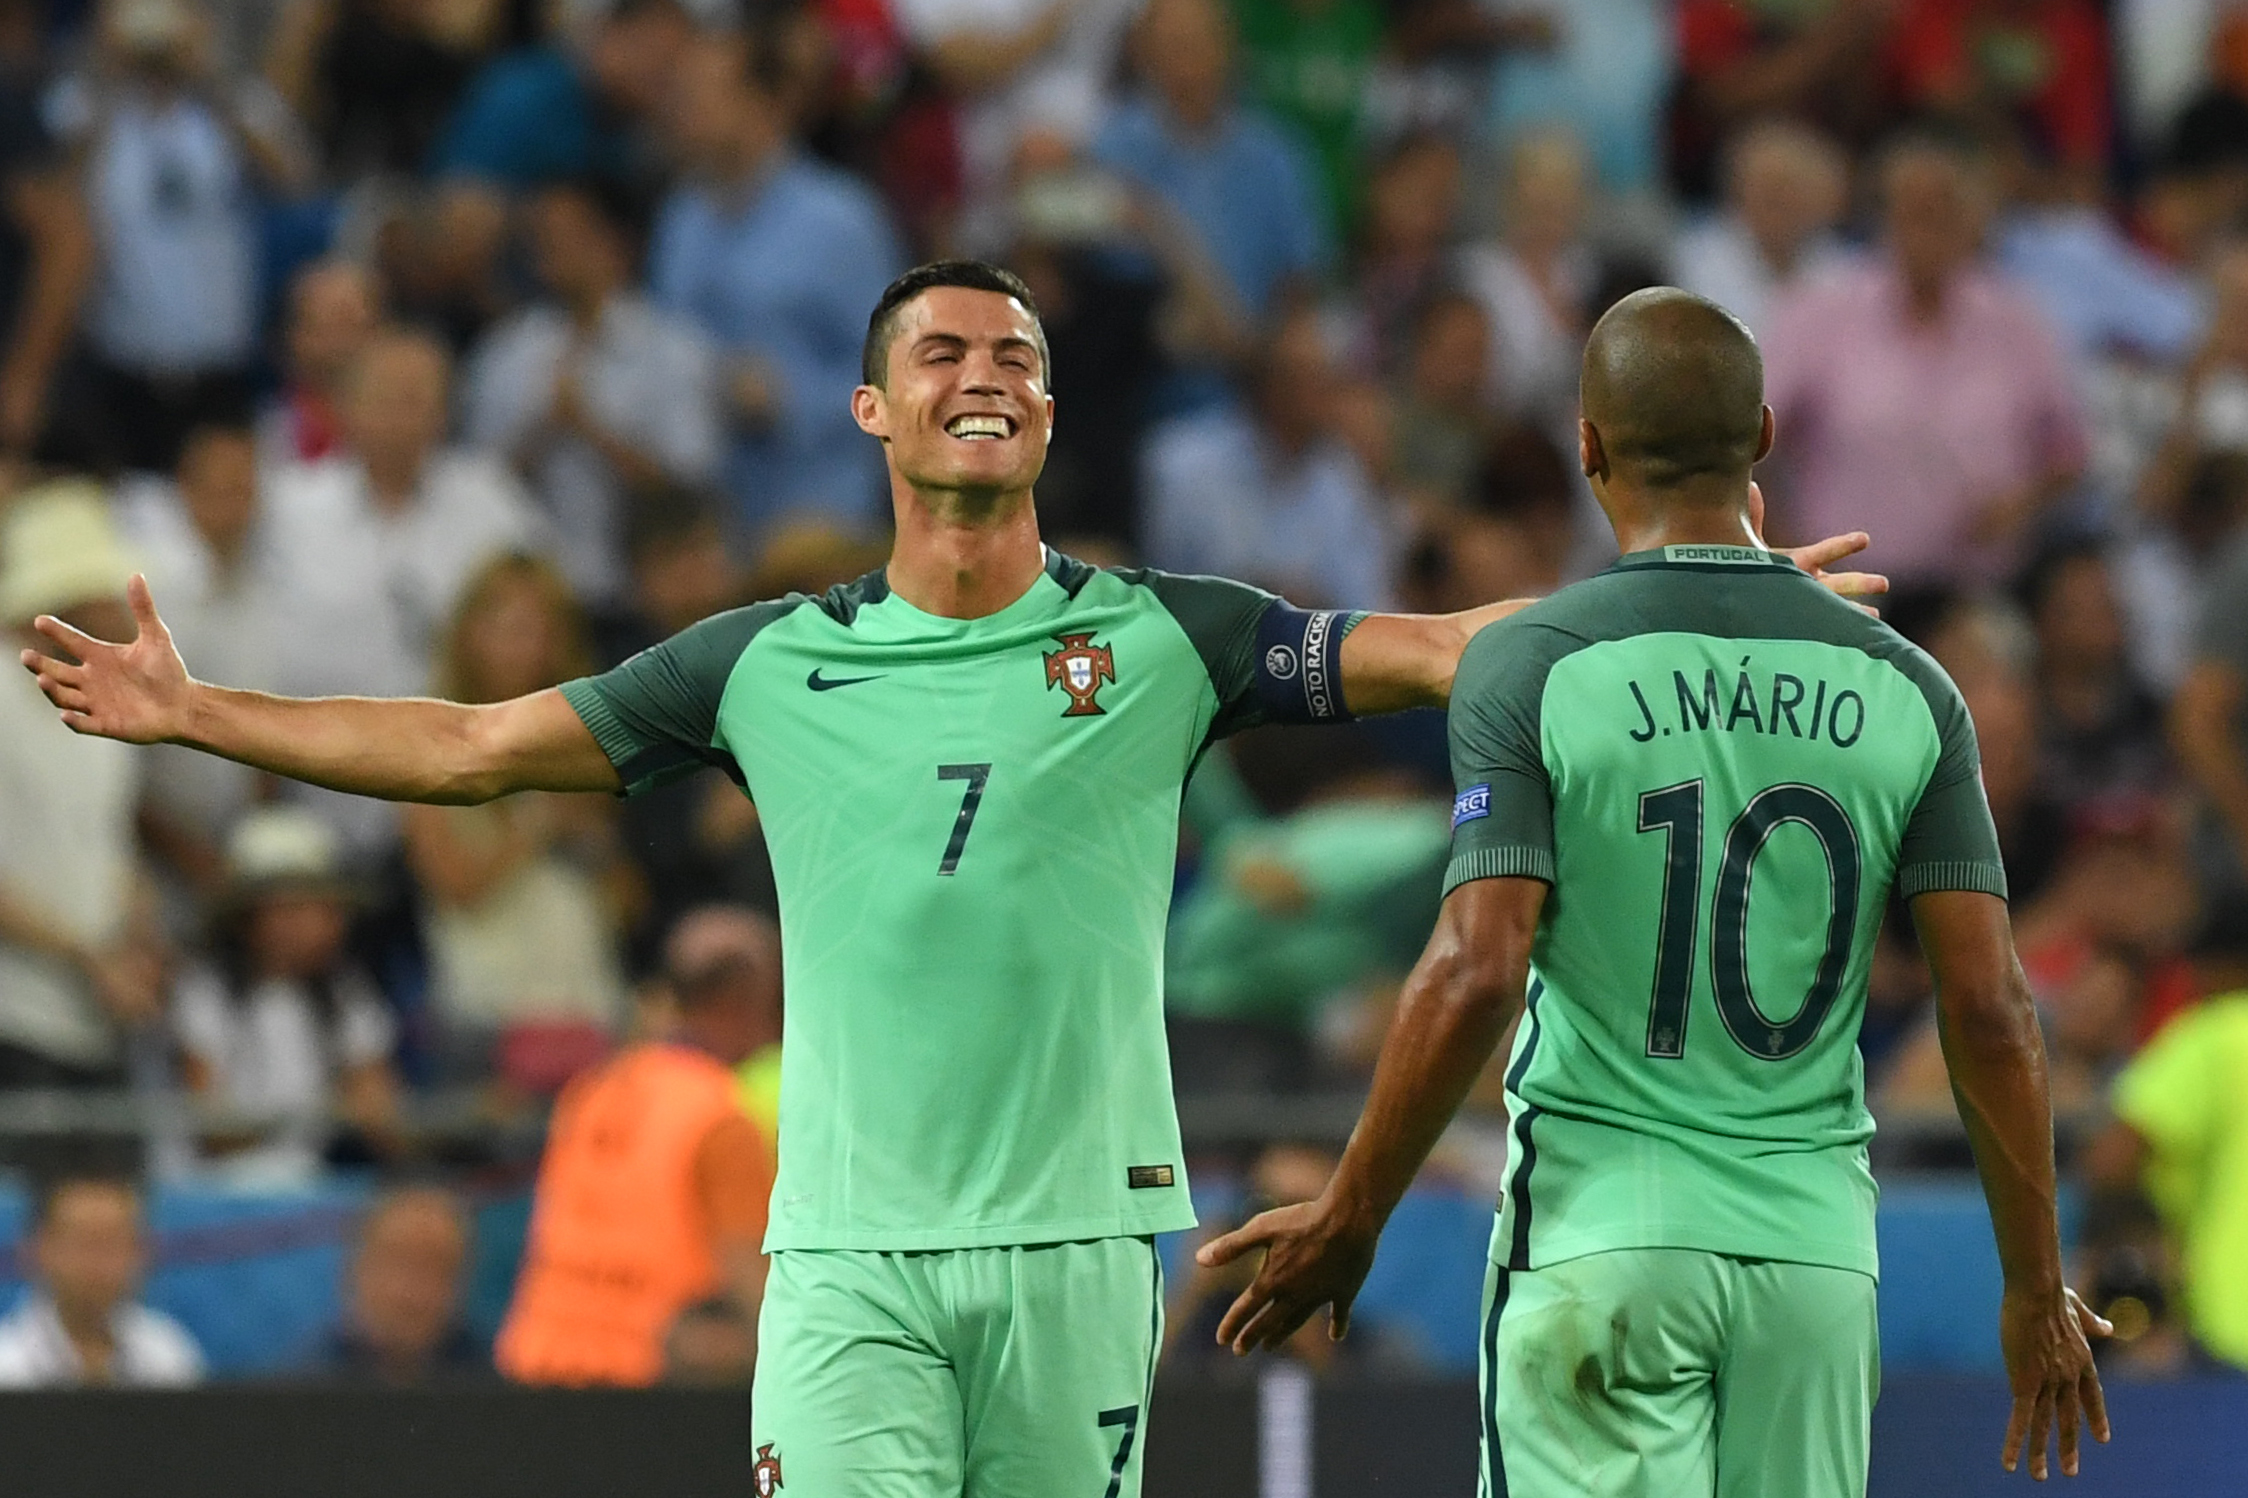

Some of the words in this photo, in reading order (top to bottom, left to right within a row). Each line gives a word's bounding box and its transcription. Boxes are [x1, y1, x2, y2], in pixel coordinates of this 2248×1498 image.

[1674, 548, 1765, 562] PORTUGAL
[1308, 671, 1323, 694] TO
[1312, 695, 1329, 717] NO
[1627, 655, 1865, 748] J.MÁRIO
[936, 763, 993, 876] 7
[1636, 776, 1862, 1061] 10
[1098, 1404, 1139, 1498] 7
